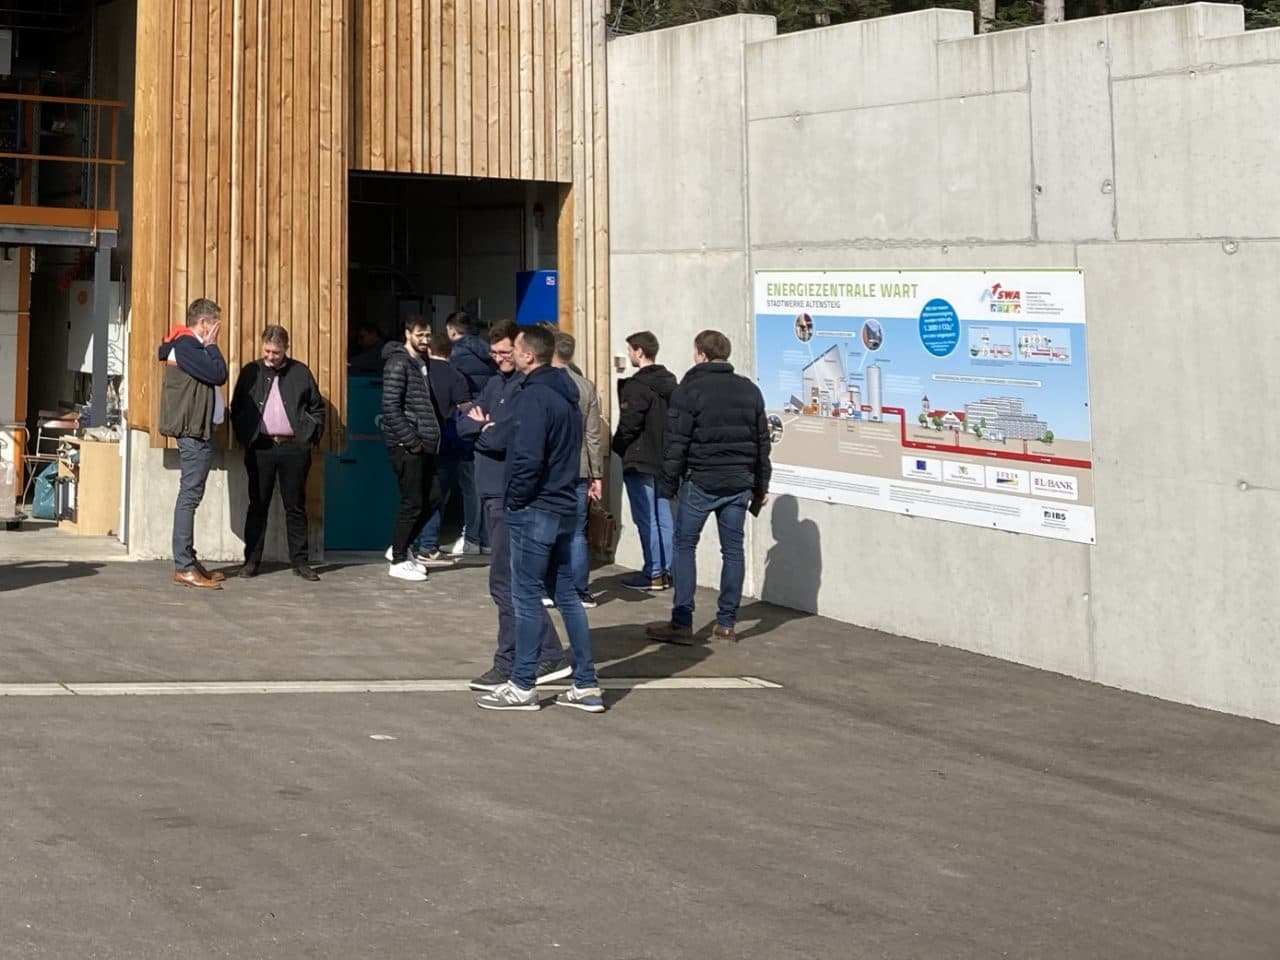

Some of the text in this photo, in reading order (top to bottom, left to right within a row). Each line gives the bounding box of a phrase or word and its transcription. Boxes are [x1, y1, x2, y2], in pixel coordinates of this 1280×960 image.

[767, 283, 919, 299] ENERGIEZENTRALE WART
[997, 291, 1021, 301] SWA
[767, 299, 840, 309] STADTWERKE ALTENSTEIG
[1052, 512, 1066, 521] IBS
